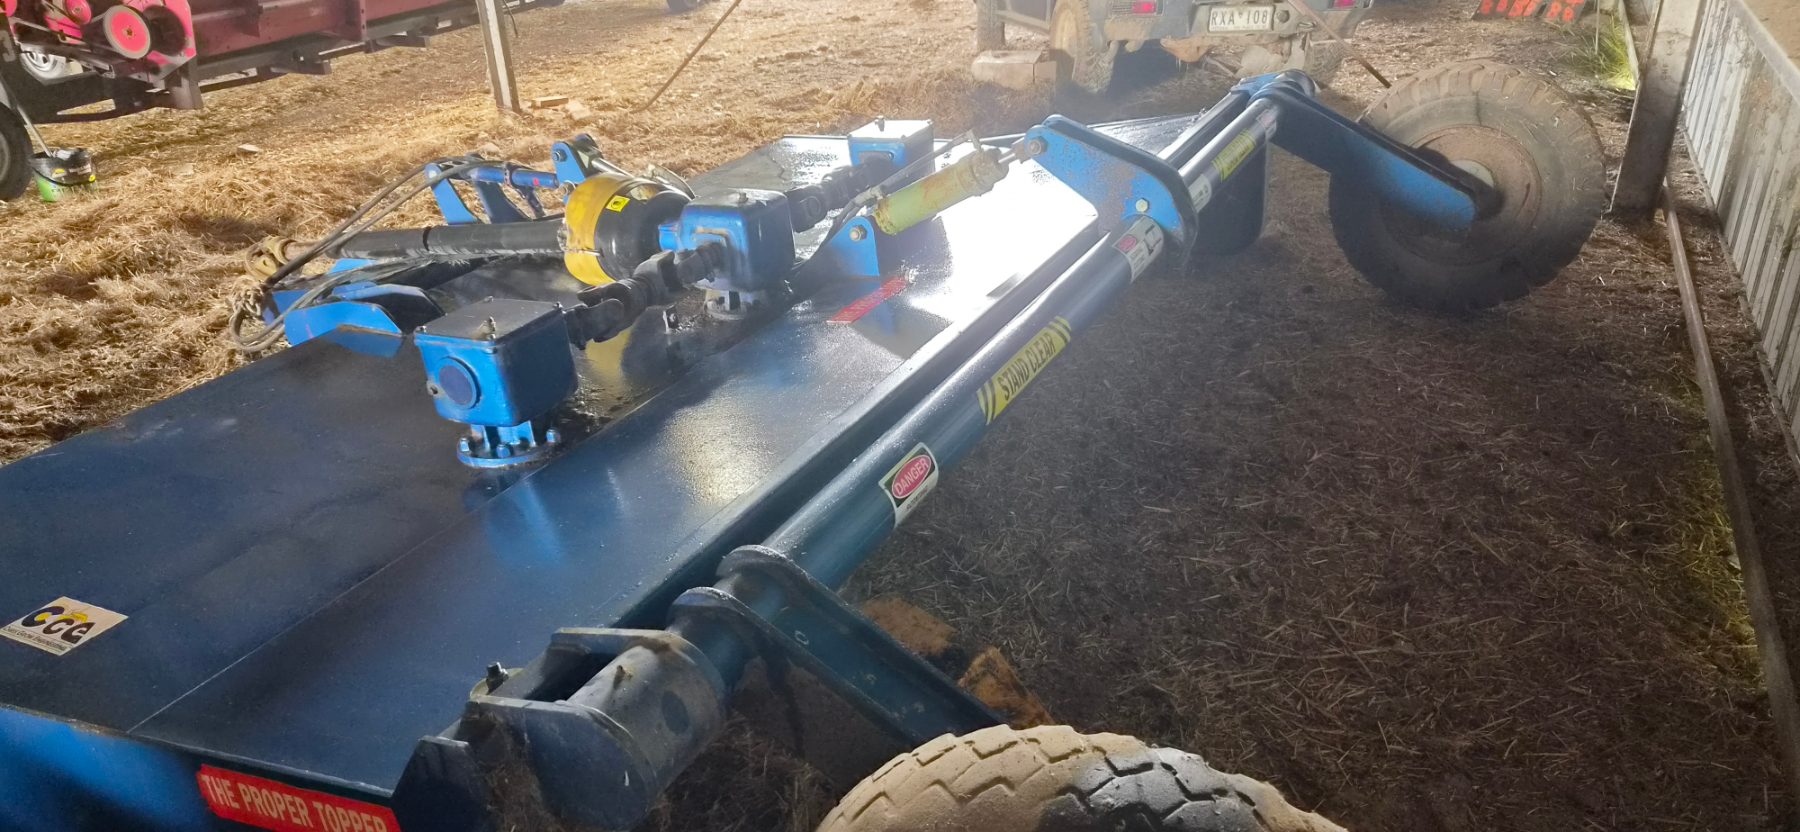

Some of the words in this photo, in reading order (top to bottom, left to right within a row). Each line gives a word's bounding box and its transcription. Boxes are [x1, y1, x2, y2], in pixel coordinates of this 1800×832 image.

[997, 357, 1030, 401] STAND
[1024, 332, 1057, 373] CLEAR
[894, 457, 929, 496] DANGER
[201, 774, 240, 809] THE
[236, 782, 314, 828] PROPER
[312, 801, 388, 832] TOPPER
